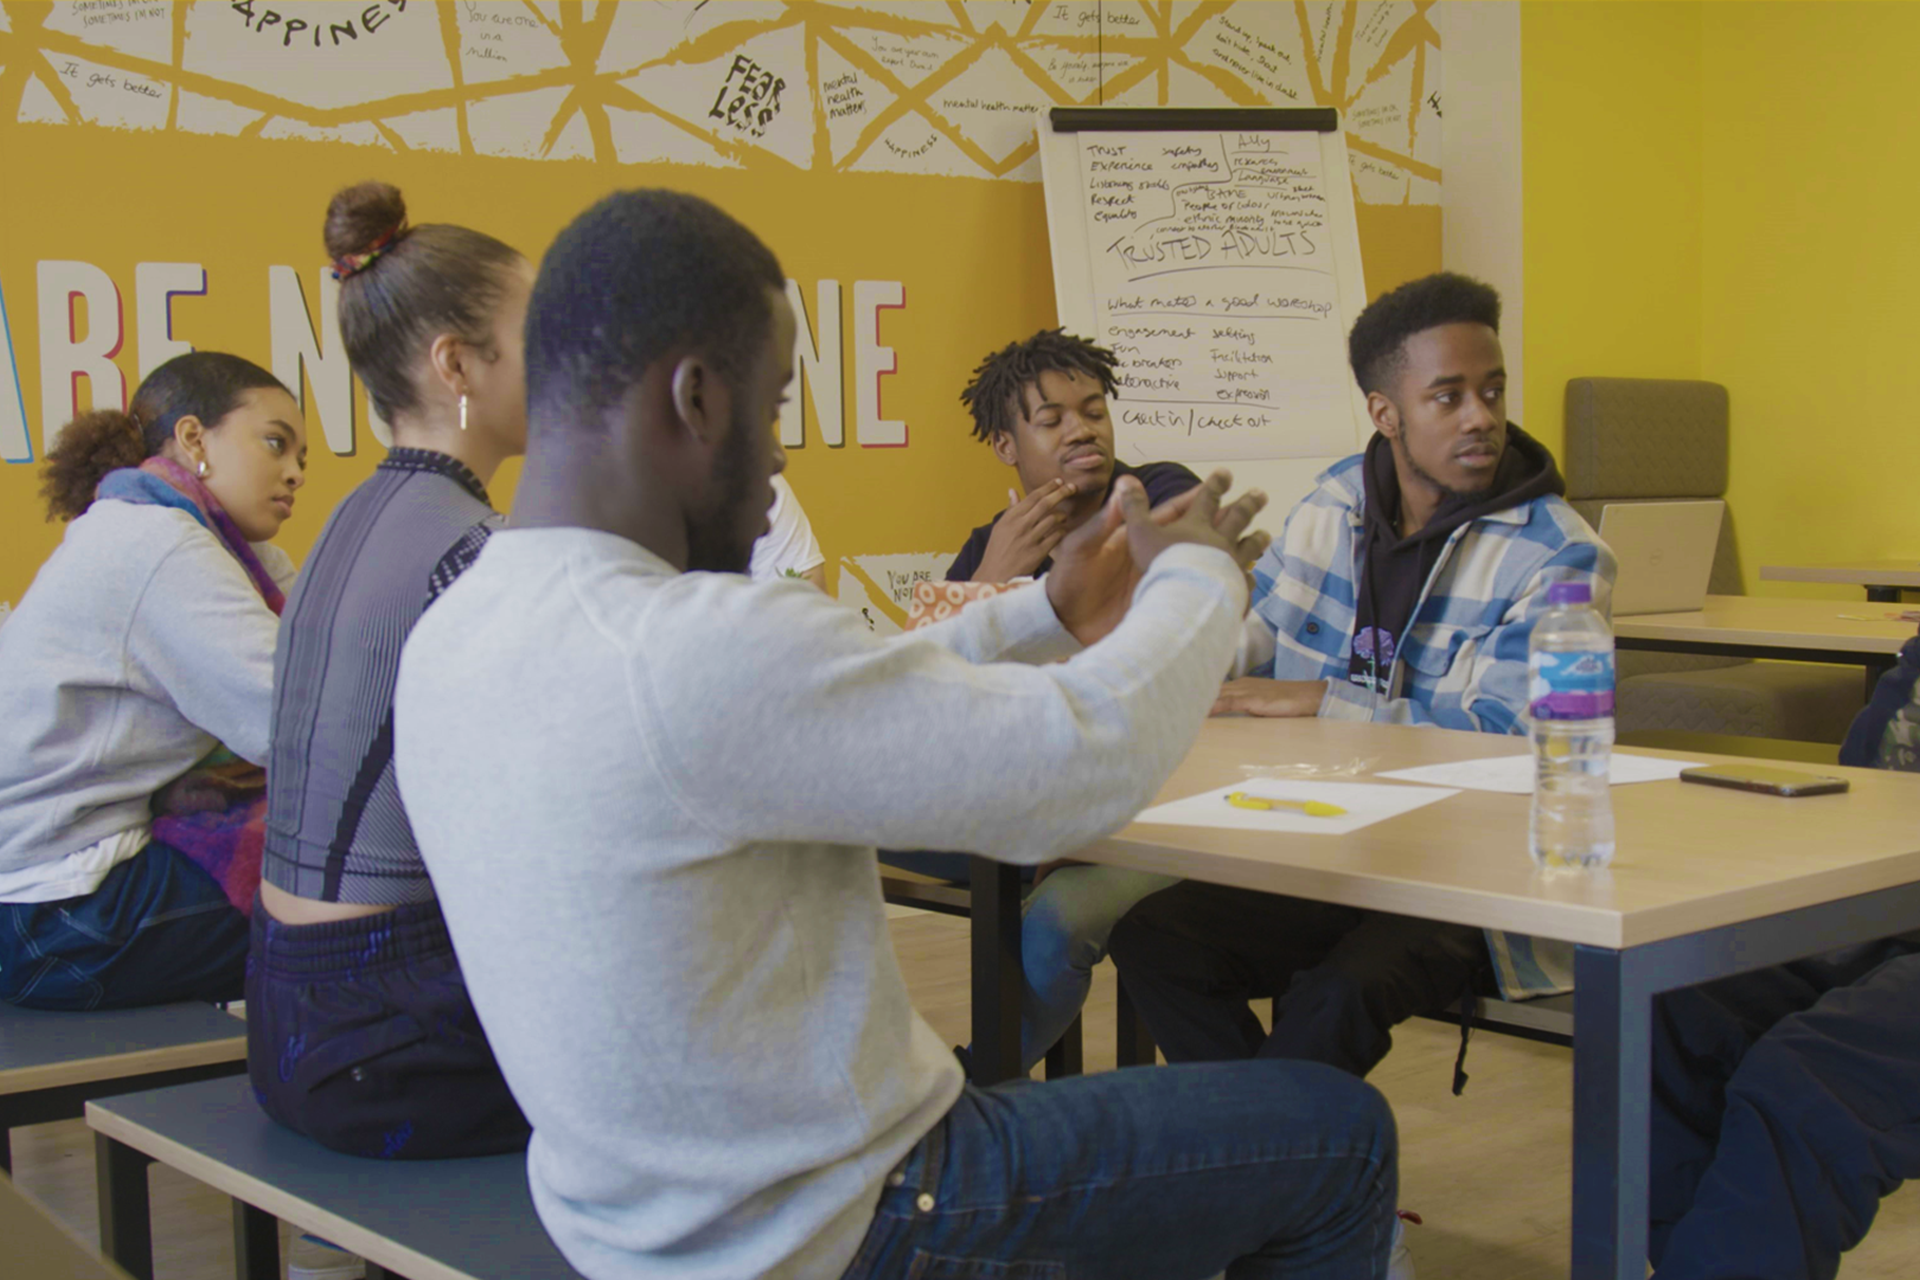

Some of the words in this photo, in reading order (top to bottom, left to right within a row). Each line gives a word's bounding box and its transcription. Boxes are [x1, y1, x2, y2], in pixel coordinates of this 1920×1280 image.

[231, 0, 406, 47] APPINE
[1053, 5, 1069, 21] It
[1077, 10, 1101, 28] gets
[1107, 12, 1141, 25] better
[59, 62, 79, 78] It
[86, 73, 116, 88] gets
[123, 79, 162, 98] better
[823, 72, 857, 92] mental
[827, 87, 863, 105] health
[943, 98, 978, 109] mental
[981, 99, 1010, 111] health
[1090, 158, 1154, 172] Experience
[1107, 234, 1211, 270] TRUSTED
[1221, 229, 1316, 260] ADULTS
[1222, 294, 1258, 312] good
[913, 571, 932, 582] ARE
